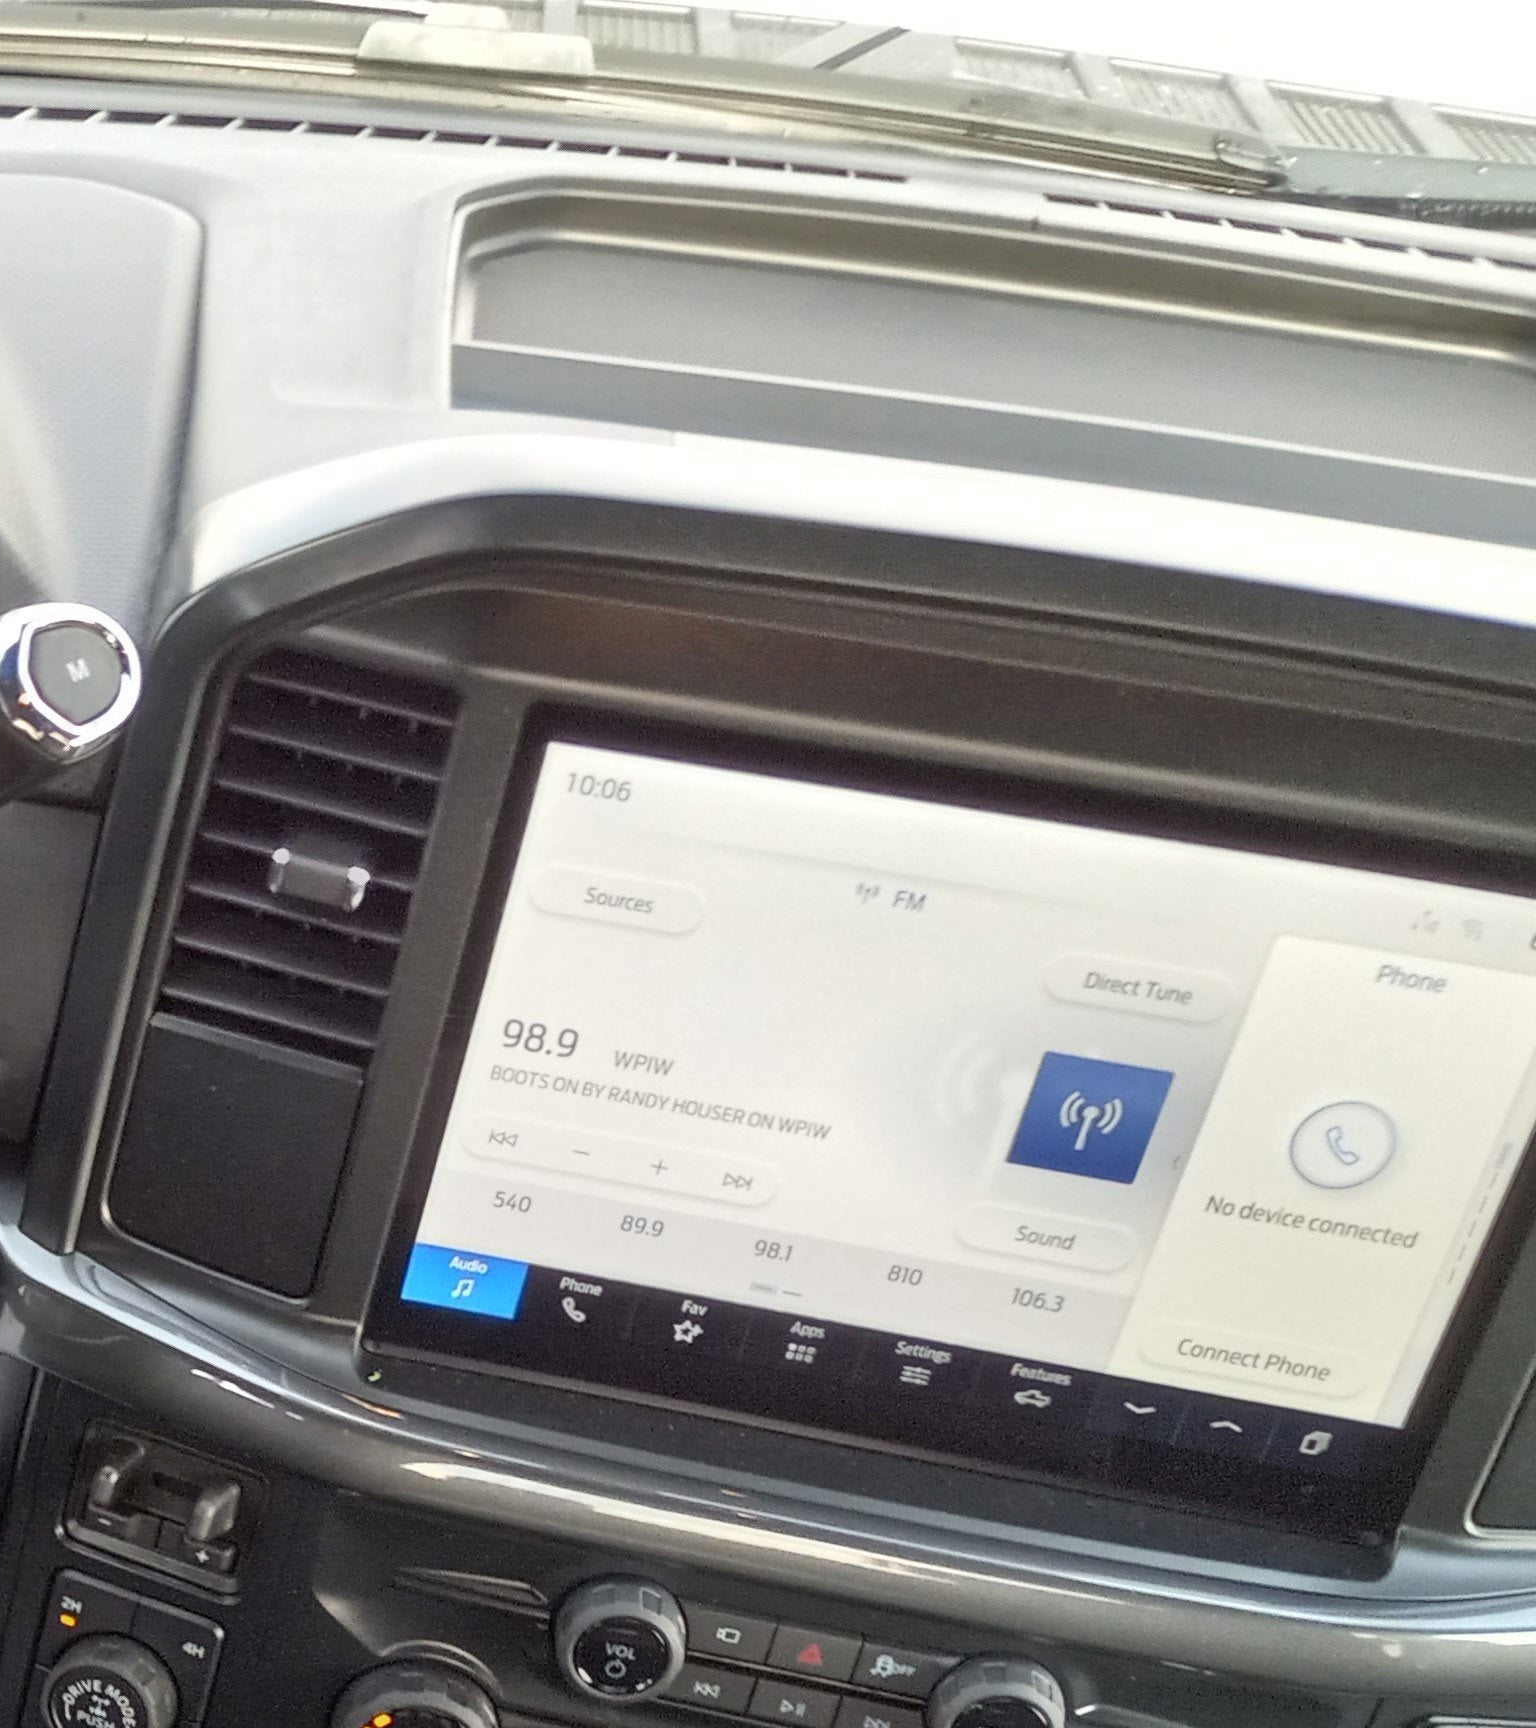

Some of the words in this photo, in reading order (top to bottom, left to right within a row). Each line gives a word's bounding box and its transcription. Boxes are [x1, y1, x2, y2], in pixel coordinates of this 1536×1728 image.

[565, 771, 632, 803] 10:06
[583, 886, 655, 914] Sources
[892, 889, 927, 912] FM
[1082, 970, 1142, 998] Direct
[1145, 980, 1195, 1006] Tune
[1375, 963, 1449, 995] Phone
[501, 1018, 580, 1058] 98.9
[612, 1049, 675, 1077] WPIW
[490, 1064, 550, 1090] BOOTS
[552, 1076, 579, 1095] ON
[580, 1081, 606, 1099] BY
[607, 1086, 670, 1112] RANDY
[671, 1098, 747, 1126] HOUSER
[747, 1111, 776, 1131] ON
[777, 1115, 833, 1141] WPIW
[492, 1190, 533, 1214] 540
[619, 1214, 665, 1238] 89.9
[1204, 1195, 1234, 1218] No
[1238, 1204, 1306, 1230] device
[1308, 1215, 1421, 1250] connected
[1014, 1224, 1077, 1251] Sound
[753, 1239, 795, 1263] 98.1
[449, 1256, 488, 1275] Audio
[886, 1264, 924, 1287] 810
[559, 1276, 604, 1297] Phone
[680, 1299, 709, 1318] Fav
[1009, 1287, 1066, 1313] 106.3
[788, 1320, 826, 1341] Apps
[894, 1340, 953, 1365] Settings
[1176, 1337, 1263, 1370] Connect
[1264, 1352, 1332, 1382] Phone
[1009, 1363, 1073, 1387] Features
[604, 1642, 637, 1661] VOL
[61, 1678, 103, 1706] DRIVE
[104, 1683, 137, 1728] MODE
